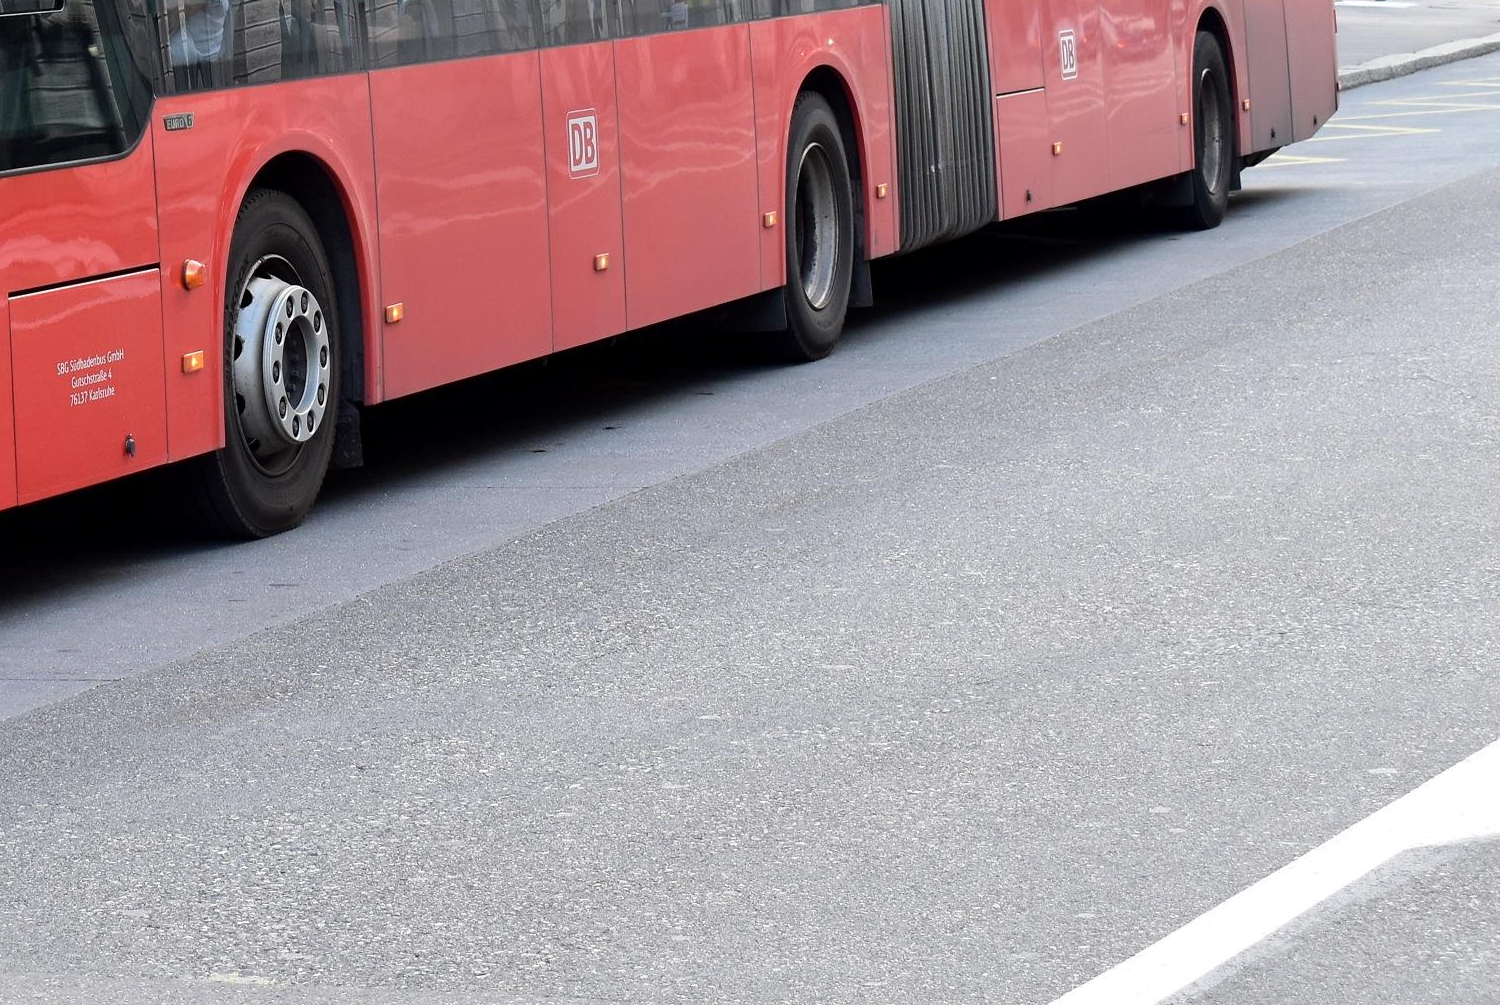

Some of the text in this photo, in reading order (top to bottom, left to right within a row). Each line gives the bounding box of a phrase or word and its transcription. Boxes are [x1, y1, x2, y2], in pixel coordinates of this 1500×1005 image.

[1062, 39, 1075, 70] DB
[166, 117, 185, 130] EURO
[571, 121, 596, 167] DB
[57, 348, 124, 376] SBG Südbadenbus GmbH
[108, 368, 112, 379] 4
[70, 385, 115, 407] 76137 Karlsruhe
